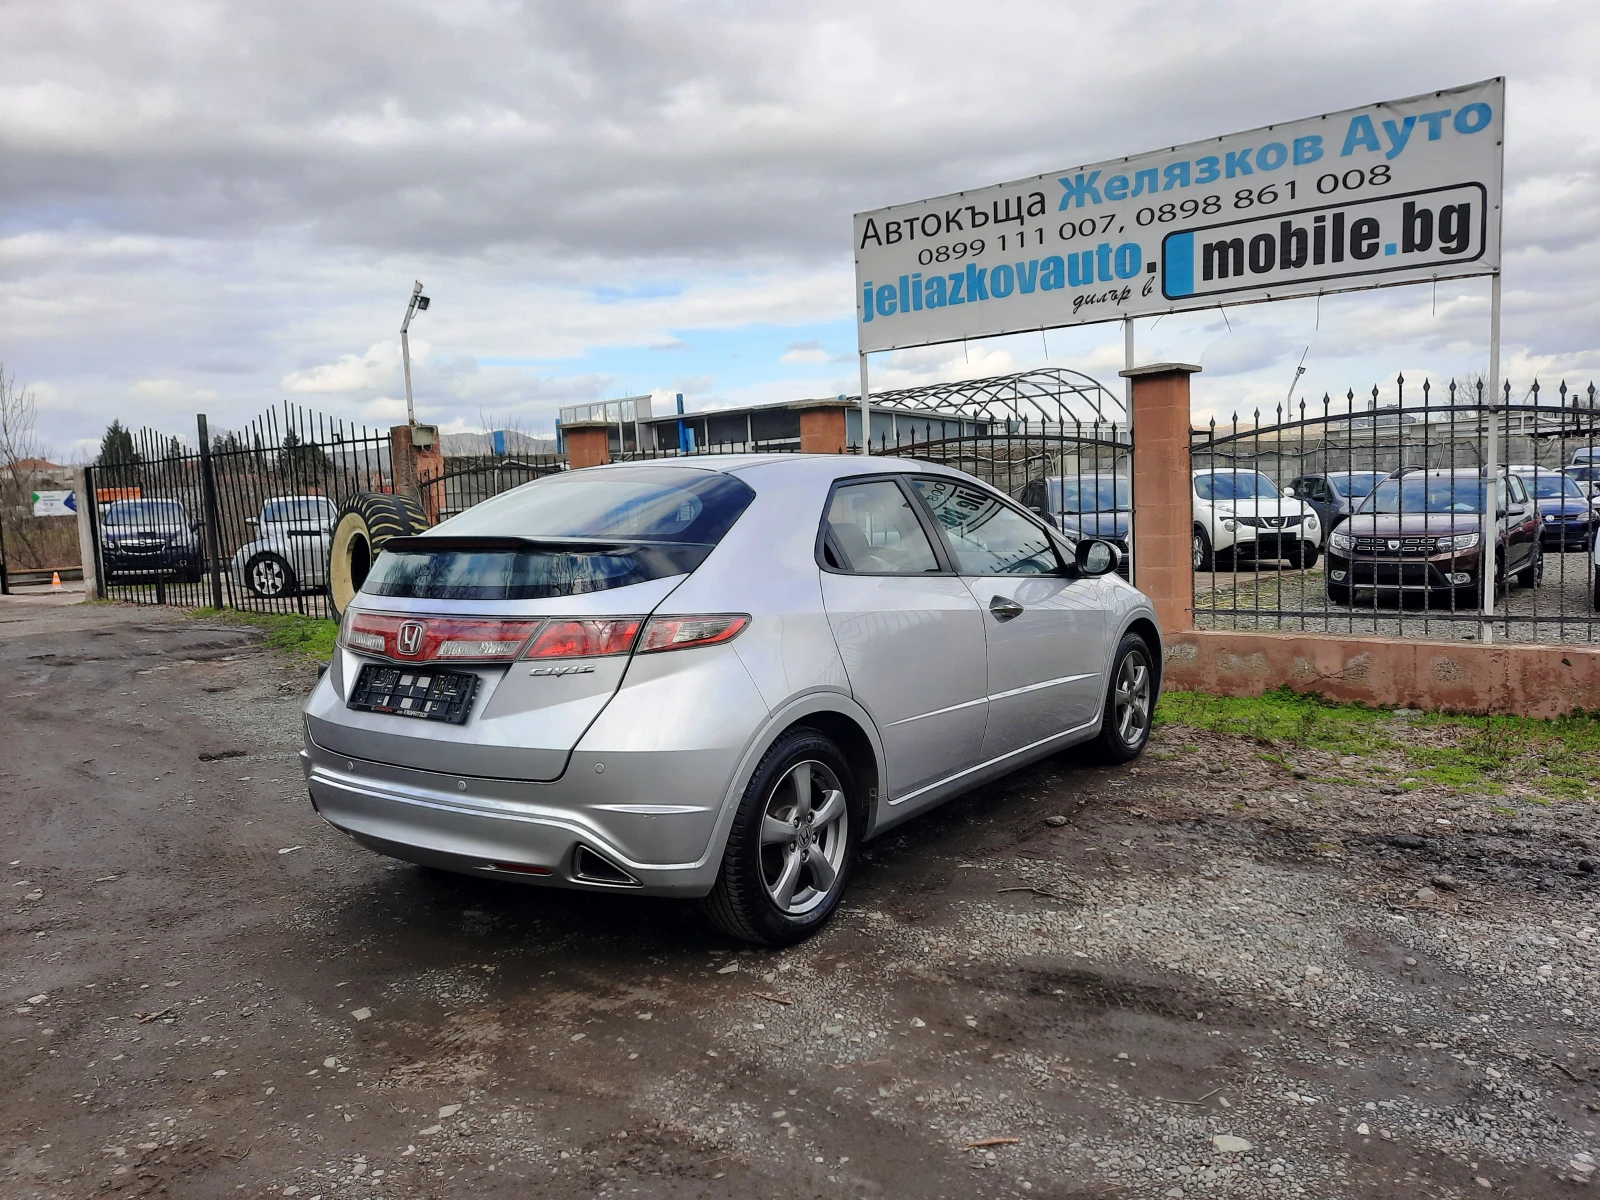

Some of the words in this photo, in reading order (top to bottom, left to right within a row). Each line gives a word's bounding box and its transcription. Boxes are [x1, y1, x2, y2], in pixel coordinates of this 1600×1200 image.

[860, 191, 1046, 250] Автокъща
[1057, 134, 1325, 212] Желязков
[1340, 101, 1493, 161] Ауто
[917, 238, 986, 266] 0899
[997, 227, 1044, 252] 111
[1058, 213, 1125, 241] 007,
[1135, 194, 1222, 227] 0898
[1233, 180, 1297, 210] 861
[1316, 164, 1393, 195] 008
[1202, 200, 1471, 282] mobile.bg
[1072, 284, 1133, 314] дилър
[529, 664, 596, 678] CIVIC
